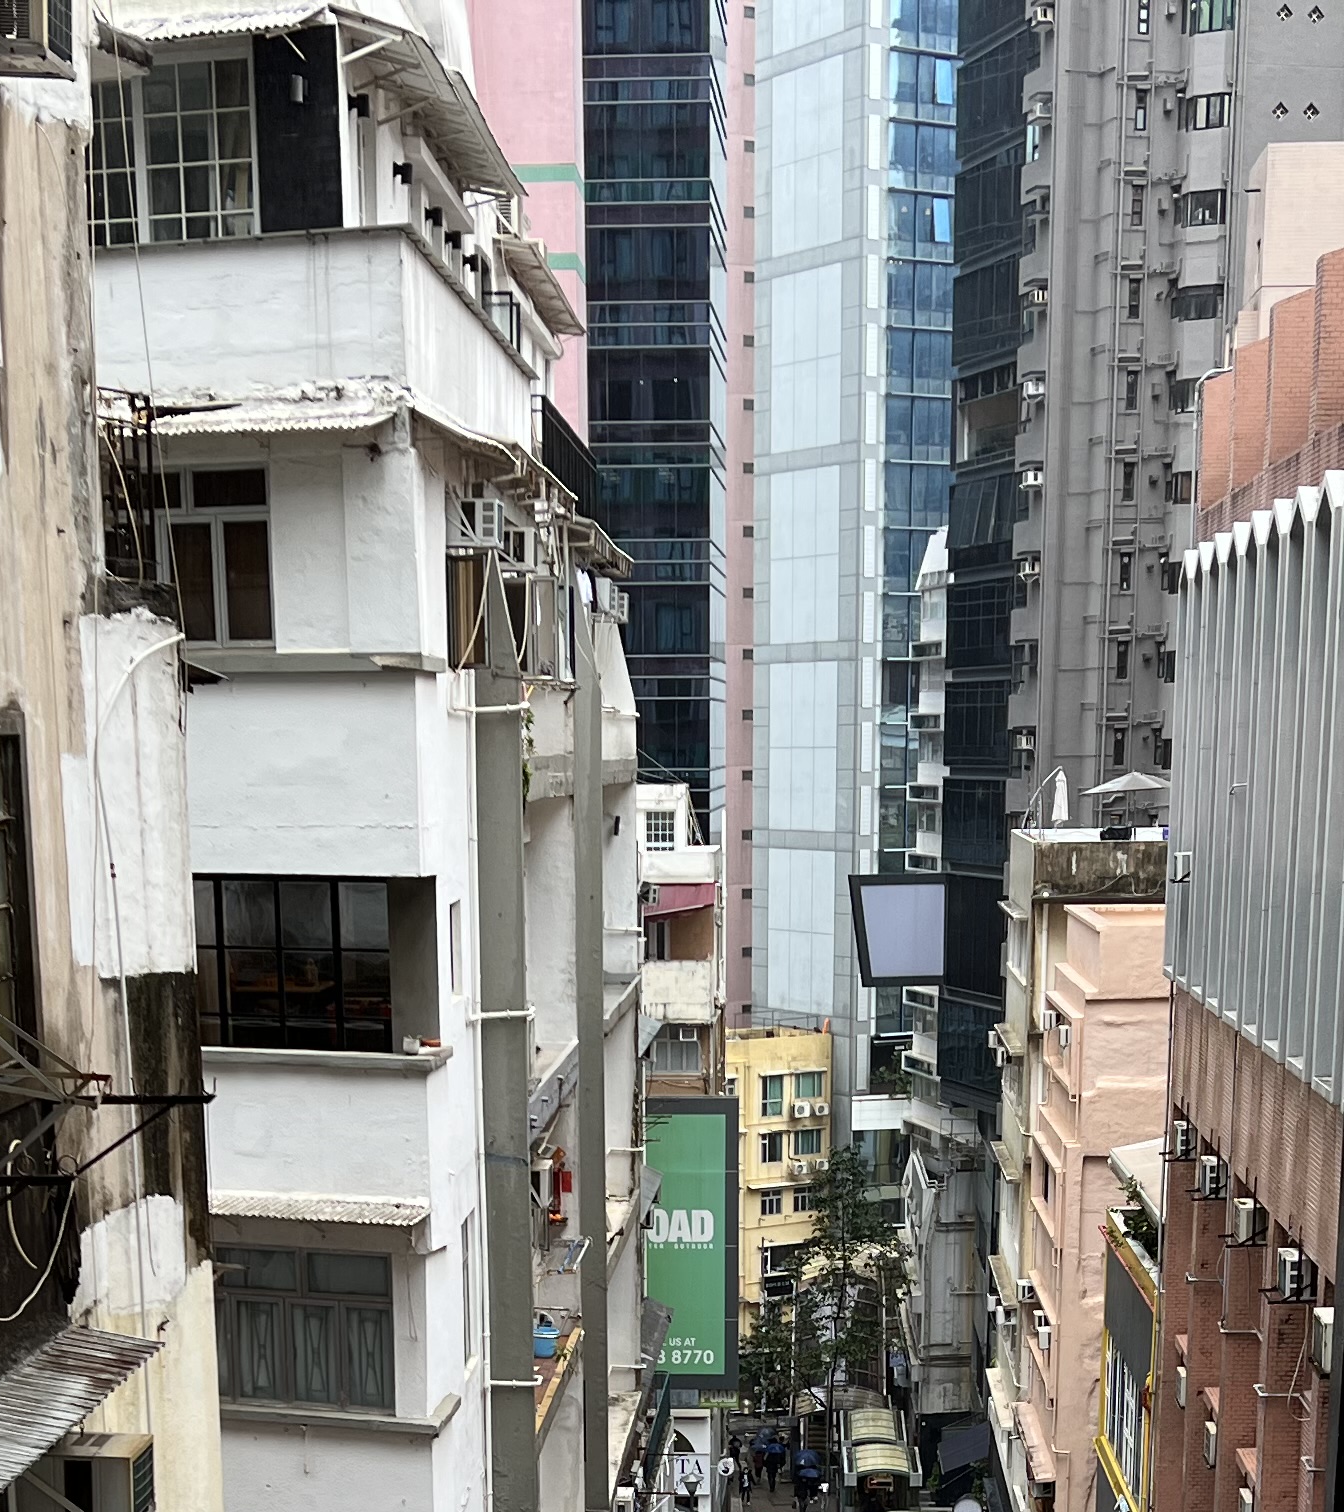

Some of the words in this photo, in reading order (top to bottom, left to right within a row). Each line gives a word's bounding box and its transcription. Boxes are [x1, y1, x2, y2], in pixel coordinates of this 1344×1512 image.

[669, 1338, 681, 1346] US
[684, 1338, 696, 1346] AT
[671, 1350, 714, 1364] 8770
